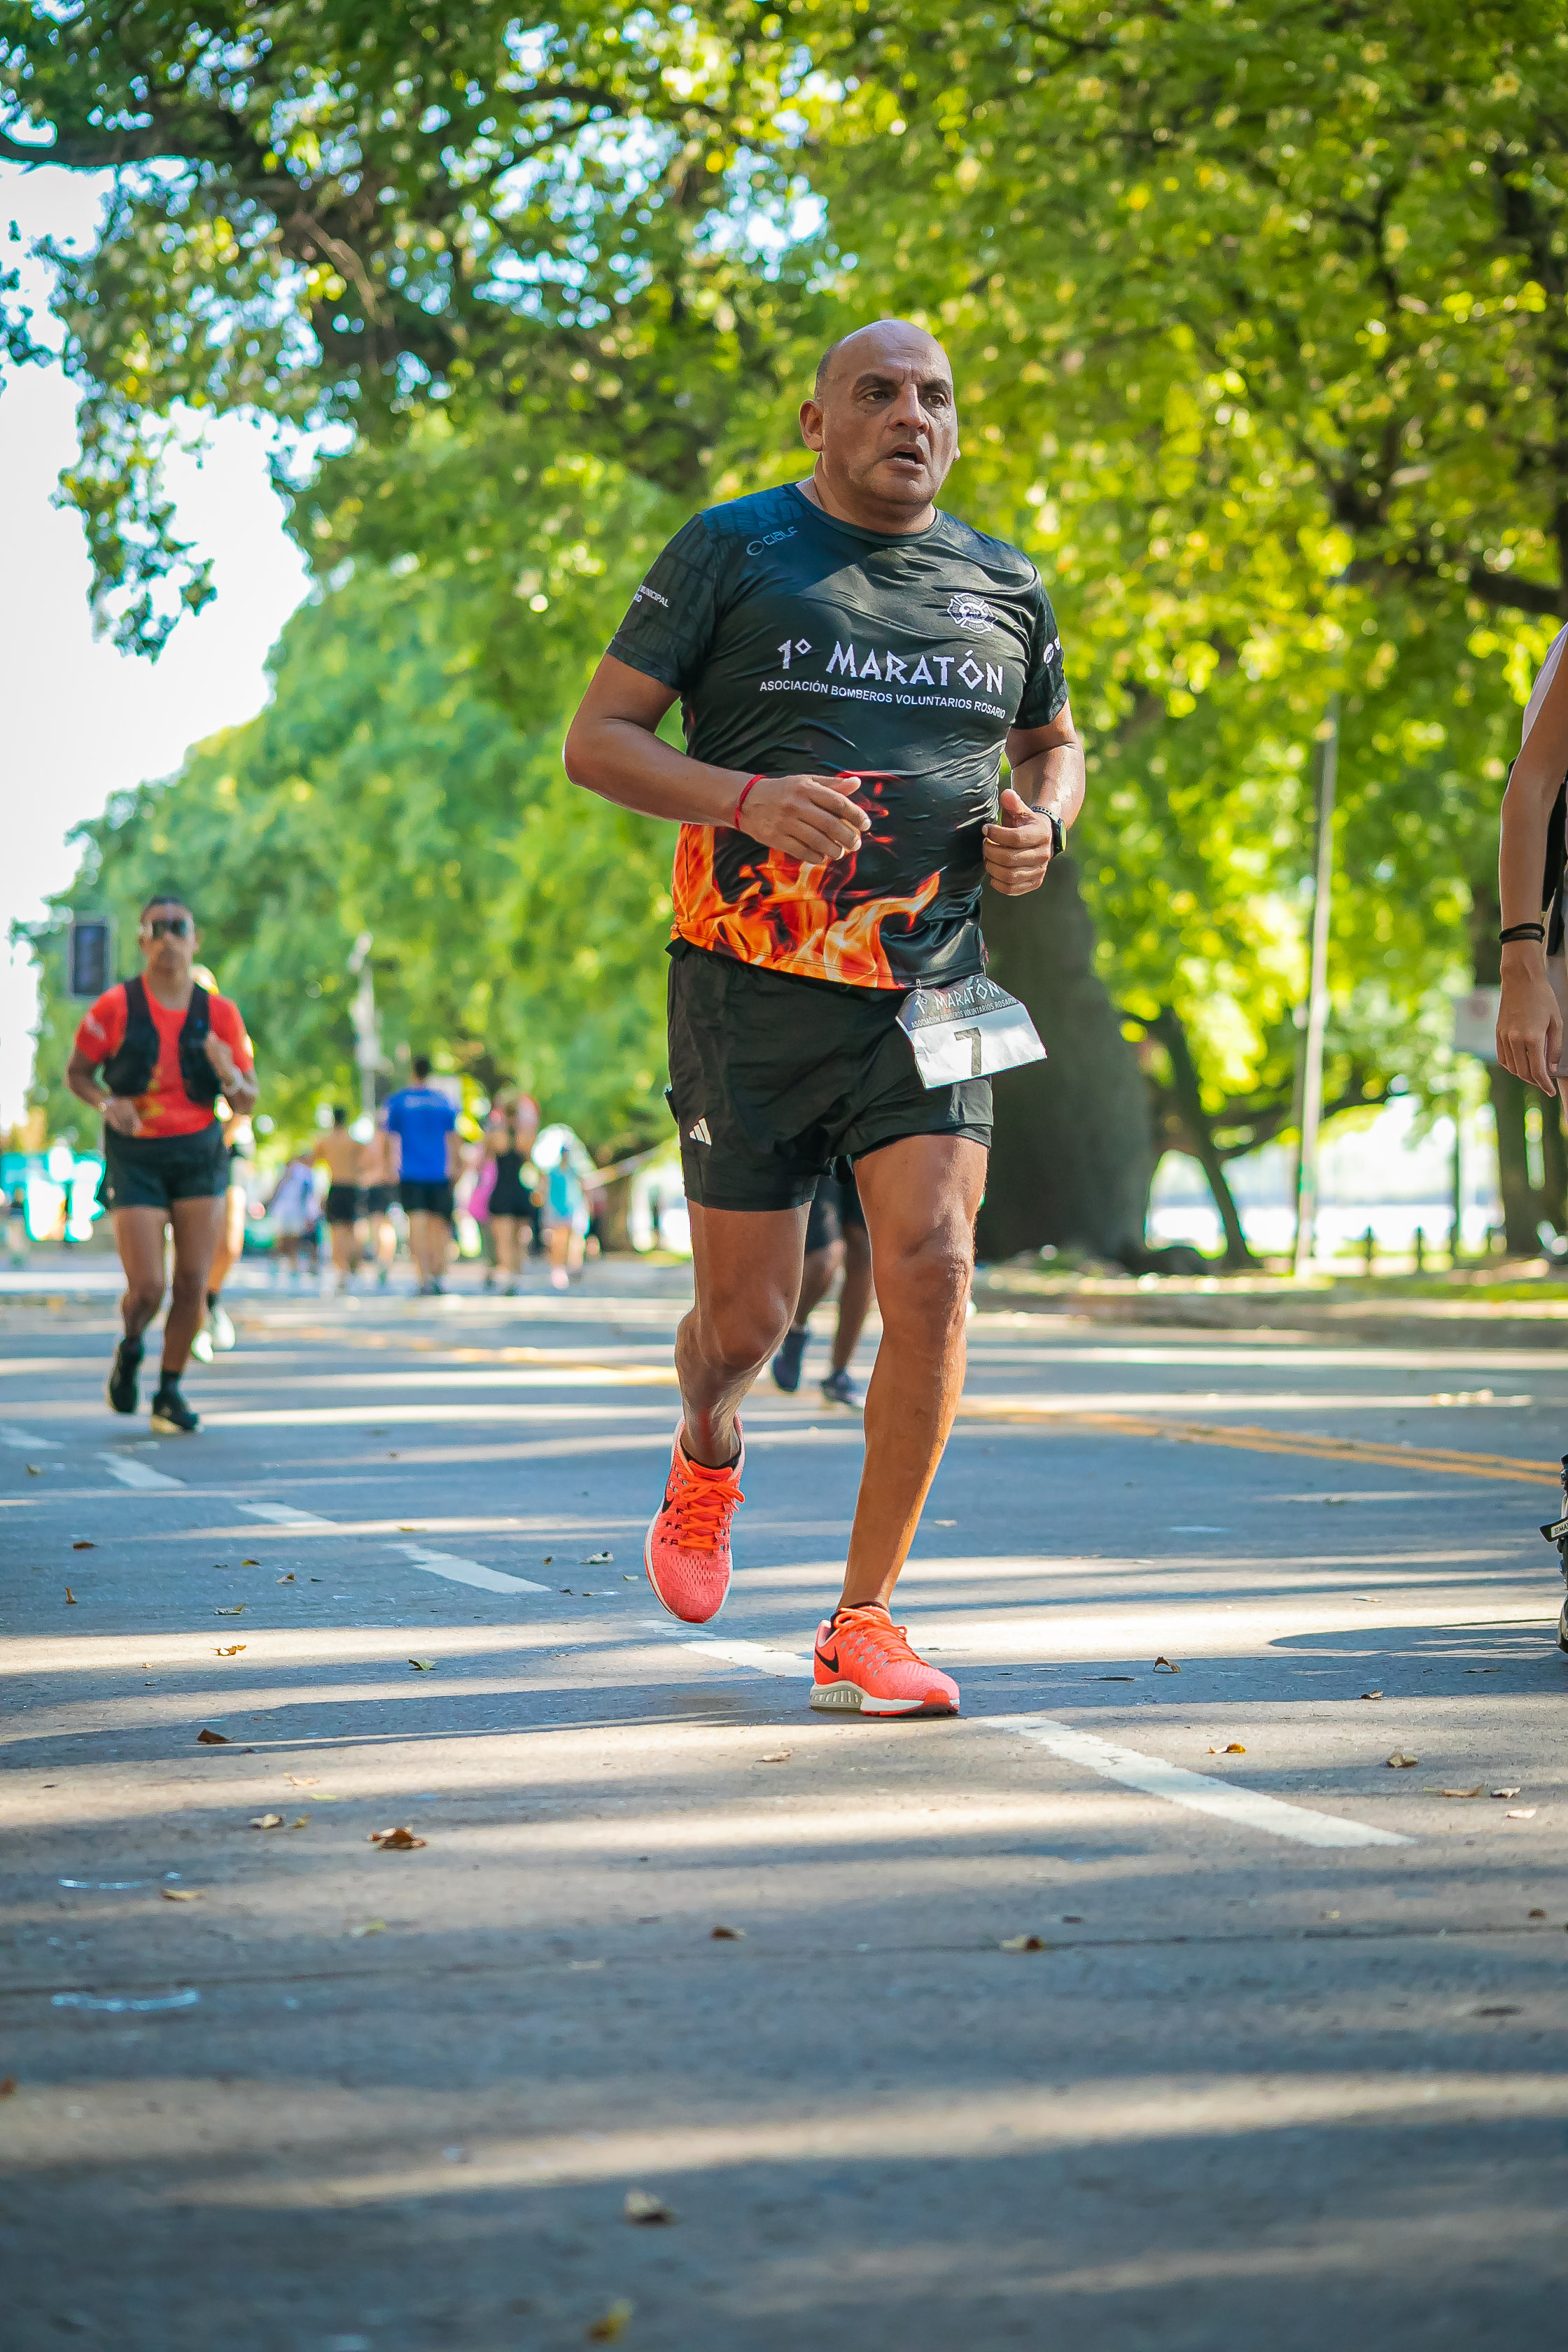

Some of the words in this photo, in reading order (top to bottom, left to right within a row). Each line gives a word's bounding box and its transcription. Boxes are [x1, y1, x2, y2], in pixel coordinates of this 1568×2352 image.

[825, 640, 1004, 696] MARATÓN
[760, 679, 828, 694] ASOCIACIÓN
[831, 685, 892, 703] BOMBEROS
[895, 694, 972, 710] VOLUNTARIOS
[974, 701, 1006, 720] ROSARIO
[934, 979, 1000, 1011] MARATÓN
[940, 1010, 964, 1022] BOMBEROS
[964, 1002, 994, 1017] VOLUNTARIOS
[994, 996, 1018, 1009] ROSARIO
[953, 1027, 981, 1077] 7
